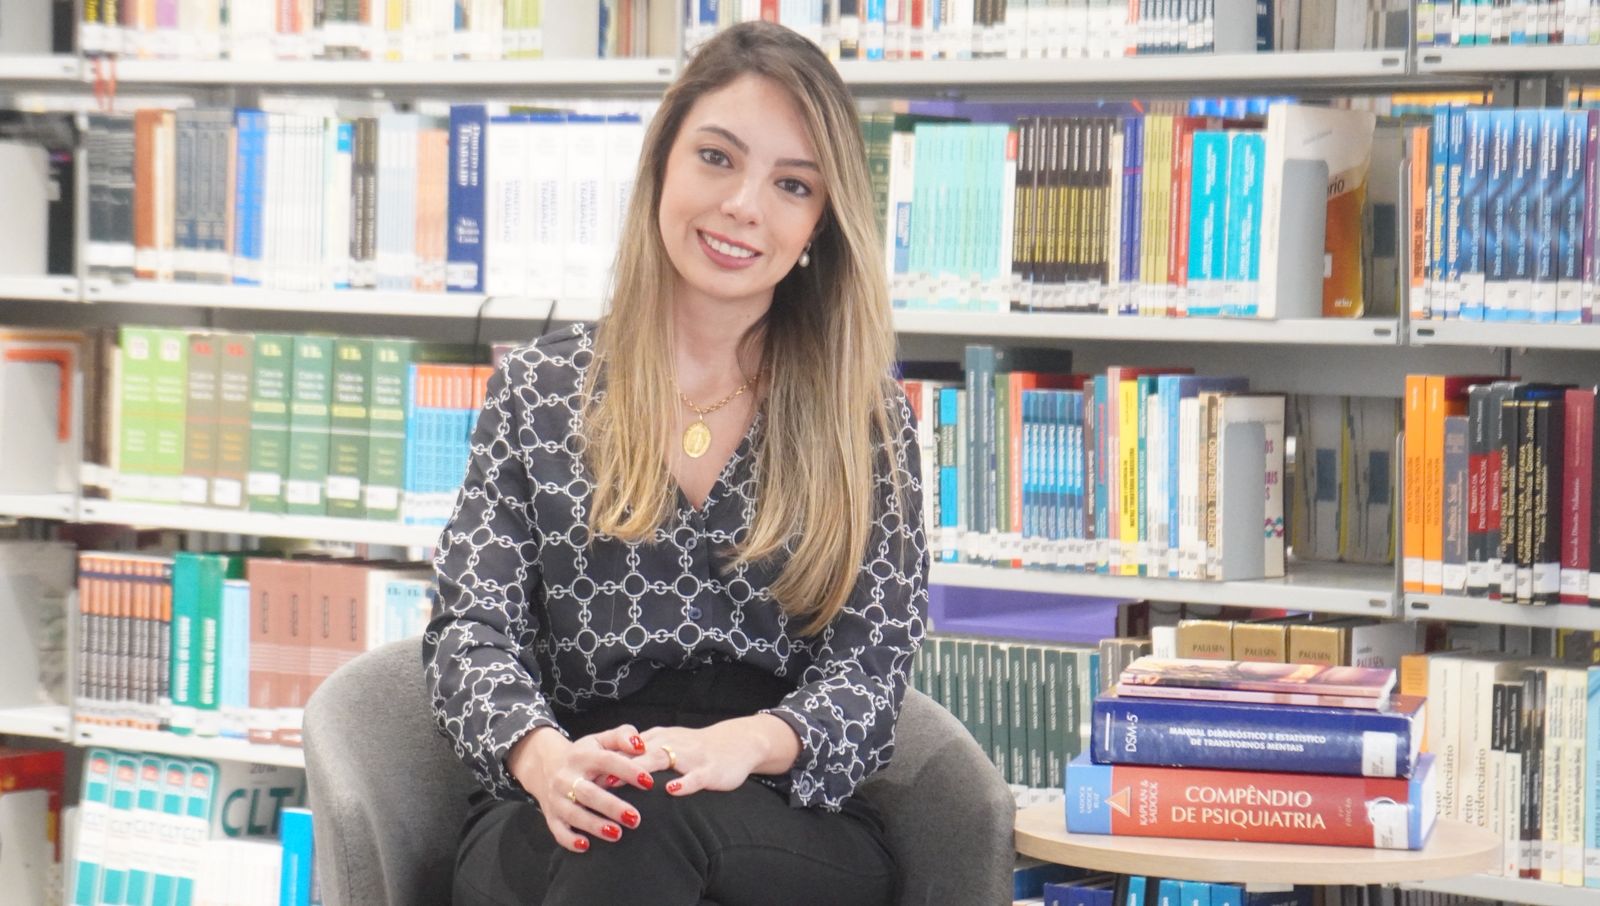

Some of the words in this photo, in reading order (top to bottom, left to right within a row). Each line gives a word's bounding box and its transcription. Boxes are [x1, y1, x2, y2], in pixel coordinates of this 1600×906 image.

[459, 124, 471, 188] TRABALHO
[470, 123, 481, 169] DIREITO
[470, 170, 480, 187] DO
[1207, 508, 1217, 548] DIREITO
[1192, 644, 1225, 654] PAULSEN
[1244, 647, 1278, 657] PAULSEN
[1298, 650, 1331, 660] PAULSEN
[1125, 714, 1138, 752] DSM-5
[1168, 726, 1206, 737] MANUAL
[1206, 728, 1267, 741] DIAGNÓSTICO
[1268, 733, 1274, 741] E
[1190, 738, 1202, 746] DE
[1204, 738, 1266, 750] TRANSTORNOS
[1266, 742, 1304, 752] MENTAIS
[1139, 780, 1149, 788] &
[1442, 744, 1454, 816] videnciário
[1475, 748, 1487, 826] evidenciário
[1139, 789, 1149, 826] KAPLAN
[1148, 782, 1158, 825] SADOCK
[1184, 784, 1312, 808] COMPÊNDIO
[1462, 794, 1473, 824] reito
[222, 787, 295, 837] CLT
[1170, 805, 1196, 825] DE
[1201, 808, 1326, 830] PSIQUIATRIA
